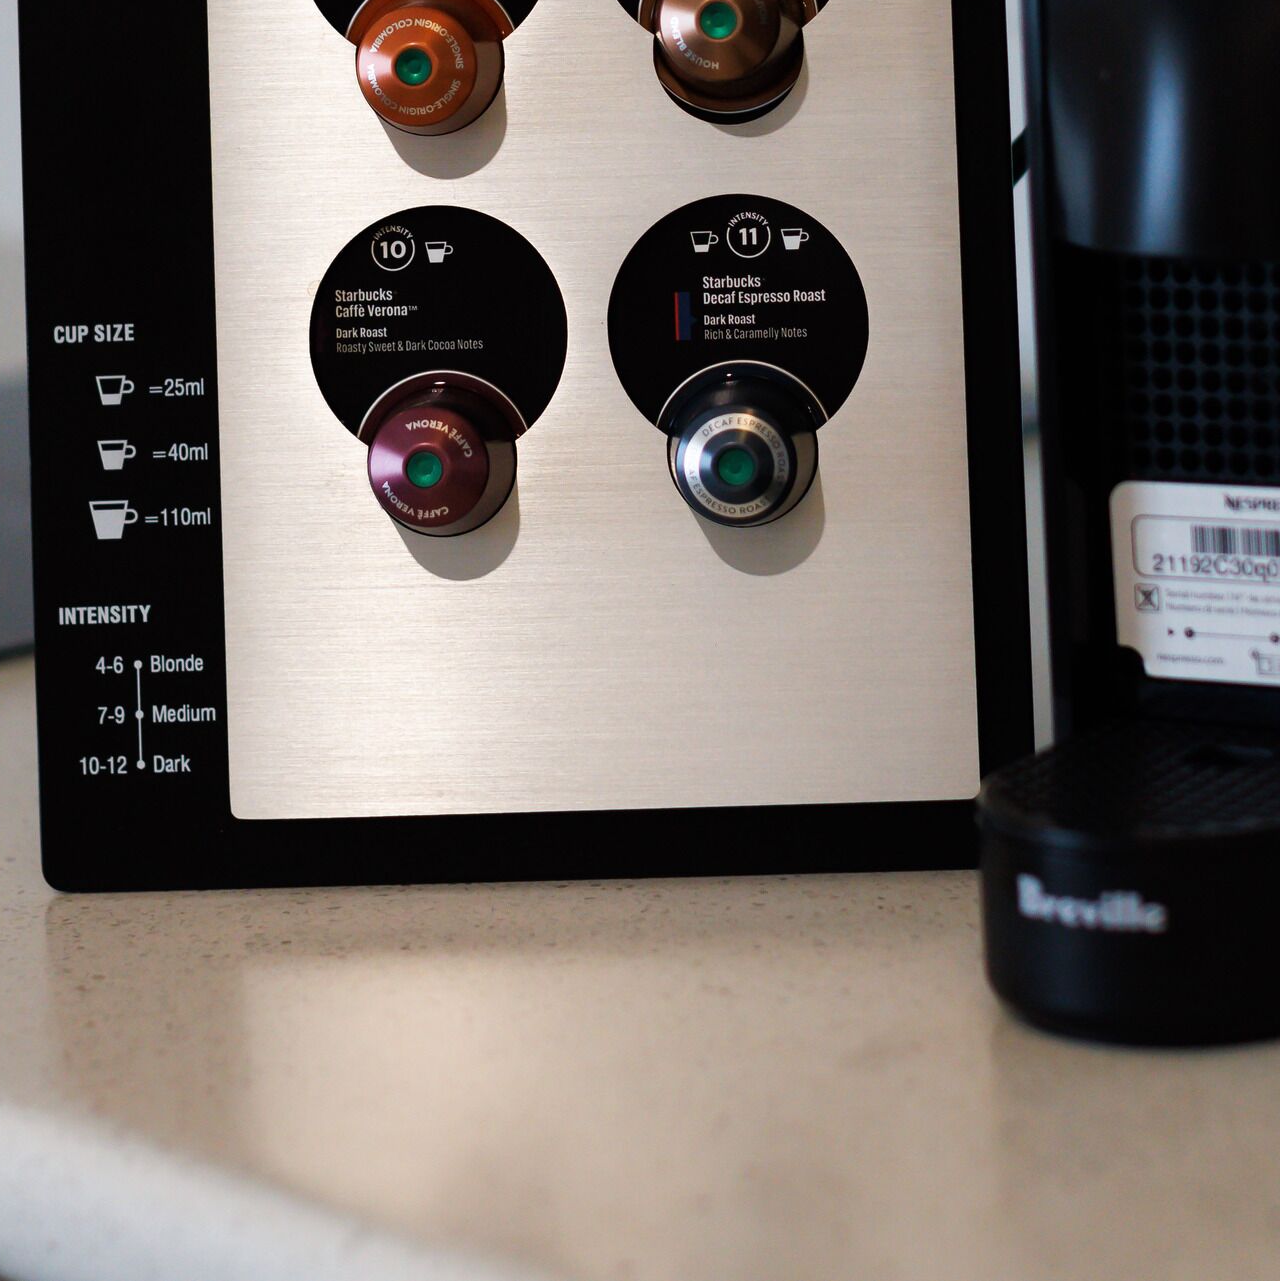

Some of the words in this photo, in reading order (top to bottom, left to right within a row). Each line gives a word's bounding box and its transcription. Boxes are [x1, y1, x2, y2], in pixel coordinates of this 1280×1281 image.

[370, 19, 412, 53] COLOMBIA
[415, 18, 464, 69] SINGLE-ORIGIN
[684, 49, 719, 69] HOUSE
[367, 64, 397, 109] COLOMBIA
[398, 79, 461, 115] SINGLE-ORIGIN
[728, 212, 768, 227] INTENSITY
[374, 225, 413, 241] INTENSITY
[739, 228, 757, 245] 11
[380, 240, 406, 259] 10
[703, 275, 760, 289] Starbucks
[335, 288, 392, 302] Starbucks
[703, 292, 735, 305] Decaf
[738, 291, 790, 306] Espresso
[793, 289, 825, 302] Roast
[336, 304, 364, 317] Caffè
[704, 314, 726, 325] Dark
[728, 314, 755, 324] Roast
[54, 325, 88, 344] CUP
[94, 324, 134, 342] SIZE
[336, 328, 358, 339] Dark
[360, 327, 387, 337] Roast
[705, 329, 723, 340] Rich
[726, 329, 732, 339] &
[734, 328, 779, 341] Caramelly
[781, 327, 807, 338] Notes
[337, 342, 366, 354] Roasty
[369, 341, 395, 352] Sweet
[397, 341, 403, 351] &
[406, 340, 426, 351] Dark
[428, 340, 455, 350] Cocoa
[457, 339, 483, 349] Notes
[405, 420, 448, 434] VERONA
[702, 417, 733, 437] DECAF
[737, 416, 779, 448] ESPRESSO
[382, 481, 414, 515] VERONA
[694, 484, 736, 514] ESPRESSO
[59, 605, 151, 625] INTENSITY
[96, 656, 123, 674] 4-6
[150, 654, 204, 672] Blonde
[98, 706, 125, 724] 7-9
[152, 705, 216, 723] Medium
[80, 756, 127, 775] 10-12
[153, 755, 191, 773] Dark
